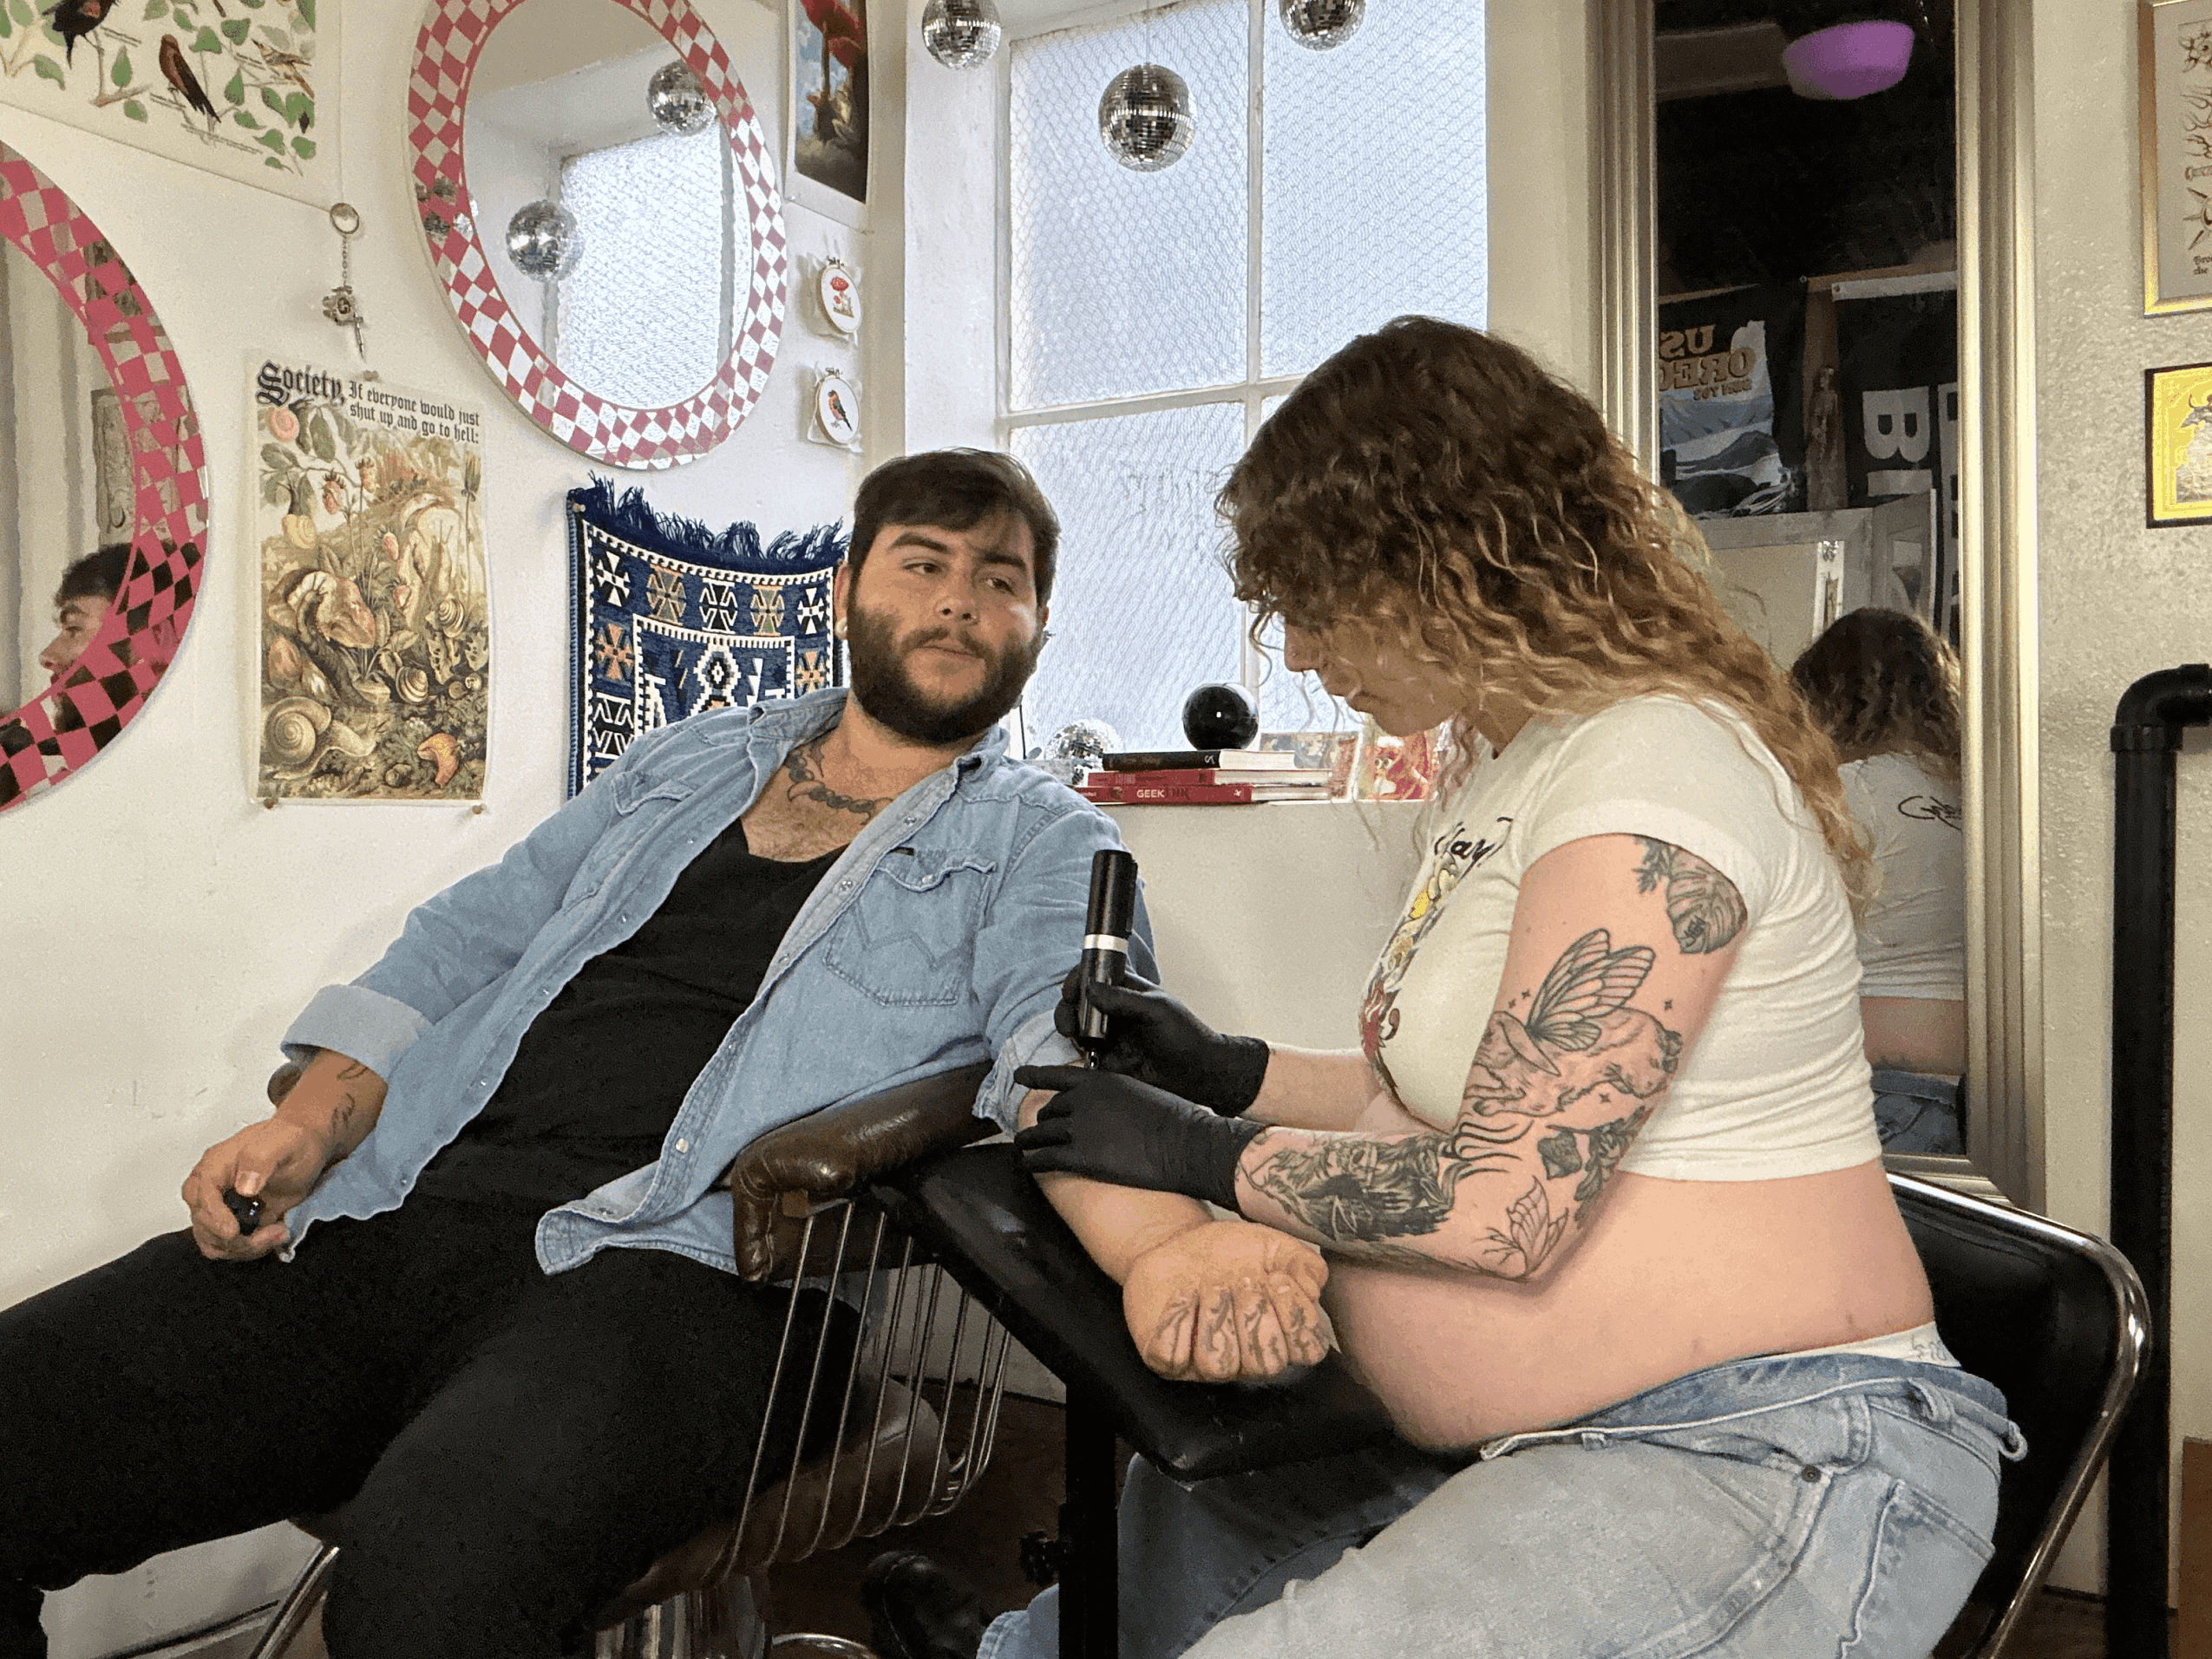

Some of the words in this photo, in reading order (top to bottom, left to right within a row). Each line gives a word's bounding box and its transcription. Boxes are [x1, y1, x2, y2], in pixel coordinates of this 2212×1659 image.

[256, 359, 346, 407] Society,
[350, 402, 376, 422] shut
[379, 409, 393, 428] up
[397, 415, 417, 431] and
[422, 421, 435, 436] go
[440, 424, 450, 438] to
[367, 387, 416, 414] everyone
[420, 399, 455, 421] would
[459, 408, 480, 427] just
